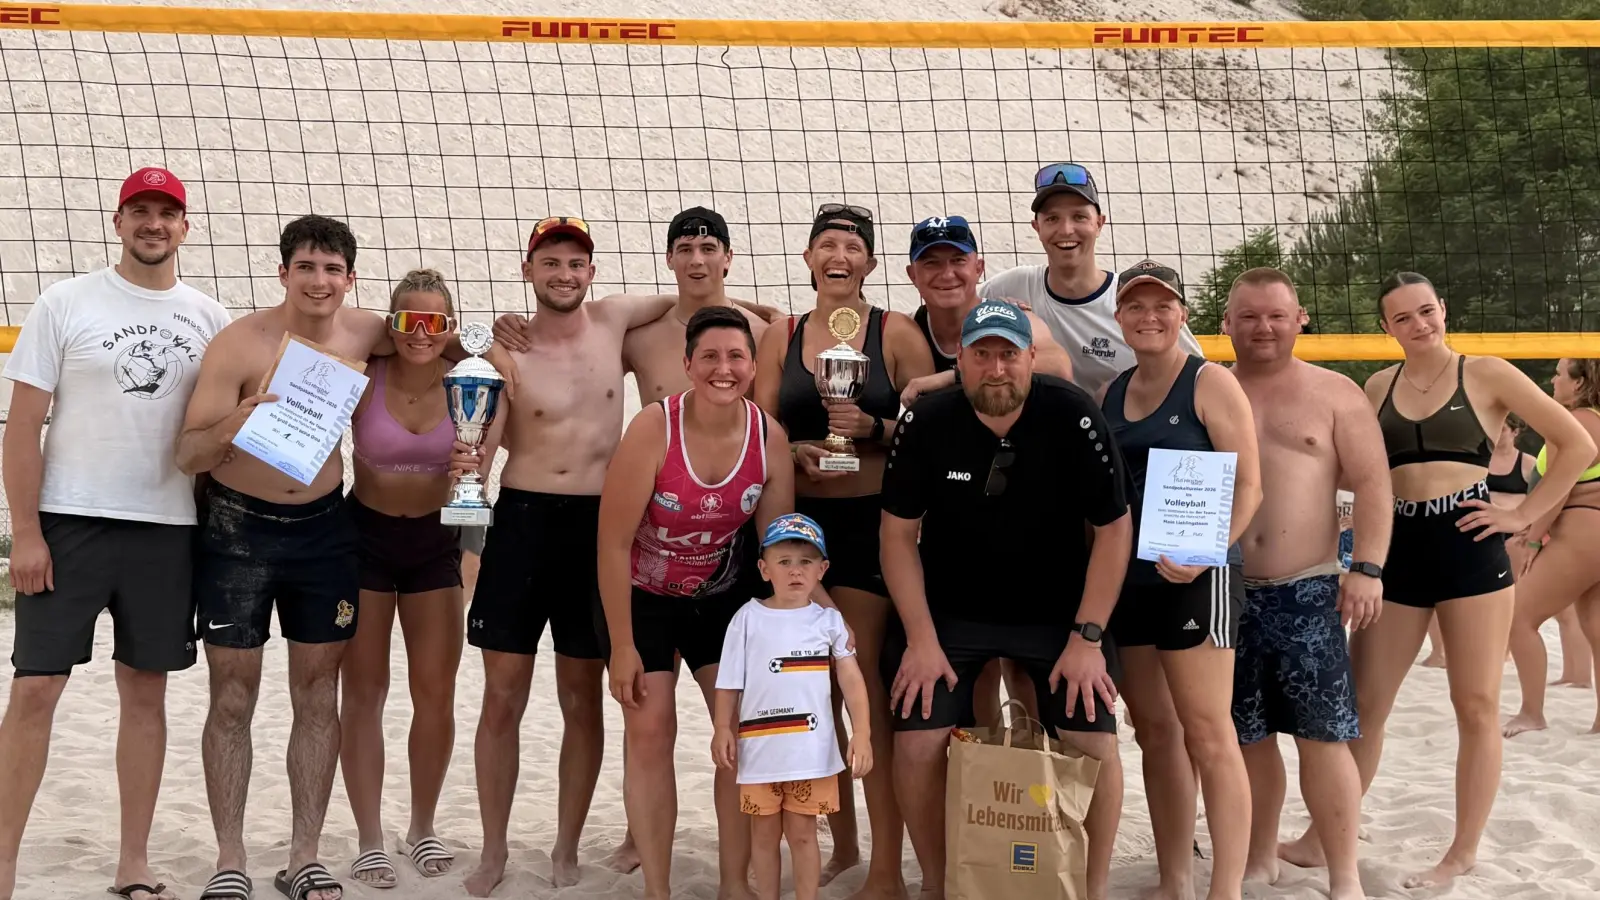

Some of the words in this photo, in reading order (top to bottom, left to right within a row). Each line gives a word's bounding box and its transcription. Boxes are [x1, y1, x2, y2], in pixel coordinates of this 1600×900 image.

[502, 21, 676, 39] FUNTEC
[1094, 27, 1264, 43] FUNTEC
[976, 304, 1016, 319] Ustka
[286, 396, 324, 420] Volleyball
[306, 384, 361, 474] URKUNDE
[393, 464, 420, 472] NIKE
[946, 471, 972, 481] JAKO
[1164, 498, 1206, 508] Volleyball
[1215, 463, 1235, 556] URKUNDE
[1391, 496, 1417, 517] RO
[1425, 486, 1475, 517] NIKE
[993, 781, 1024, 804] Wir
